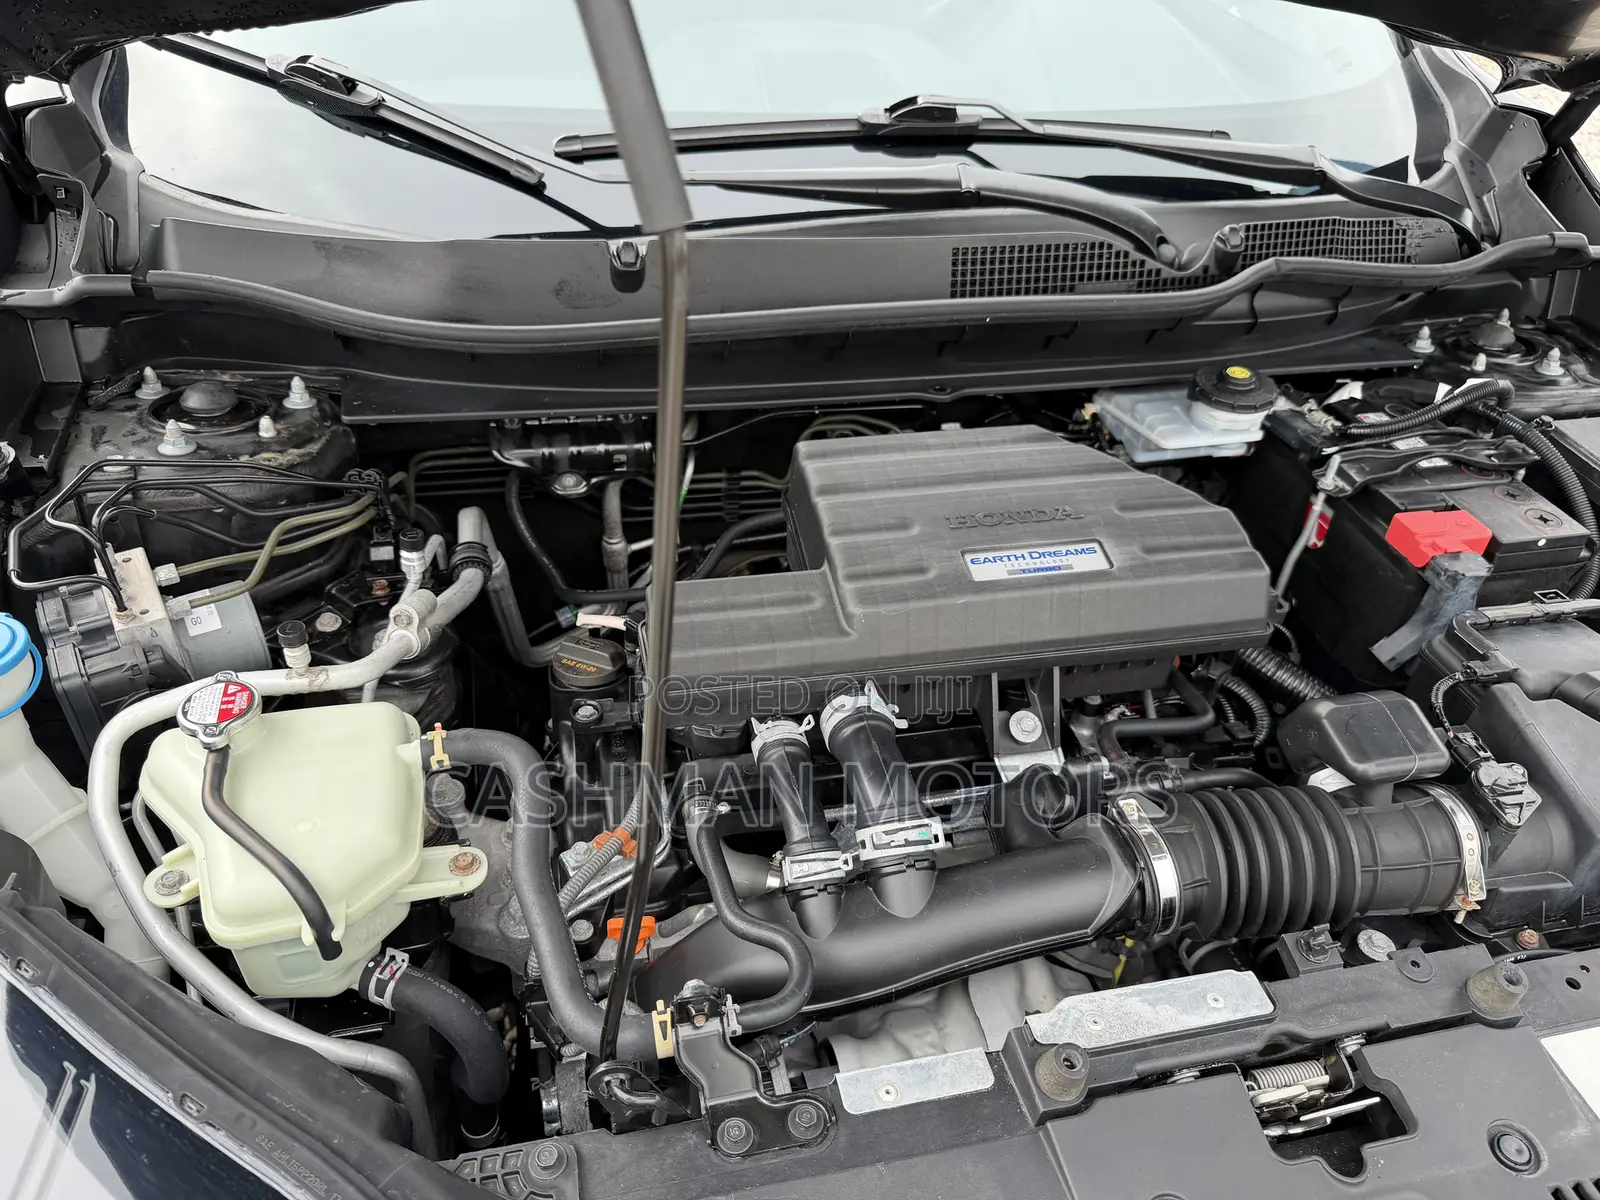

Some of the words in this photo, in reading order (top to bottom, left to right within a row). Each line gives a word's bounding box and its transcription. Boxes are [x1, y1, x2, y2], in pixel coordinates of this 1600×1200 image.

[945, 505, 1084, 529] HONDA
[970, 553, 1026, 565] EARTH
[1028, 546, 1097, 560] DREAMS
[1003, 558, 1070, 568] TECHNOLOGY
[1019, 565, 1062, 574] TURBO
[560, 658, 577, 667] SAE
[256, 1134, 275, 1151] SAE
